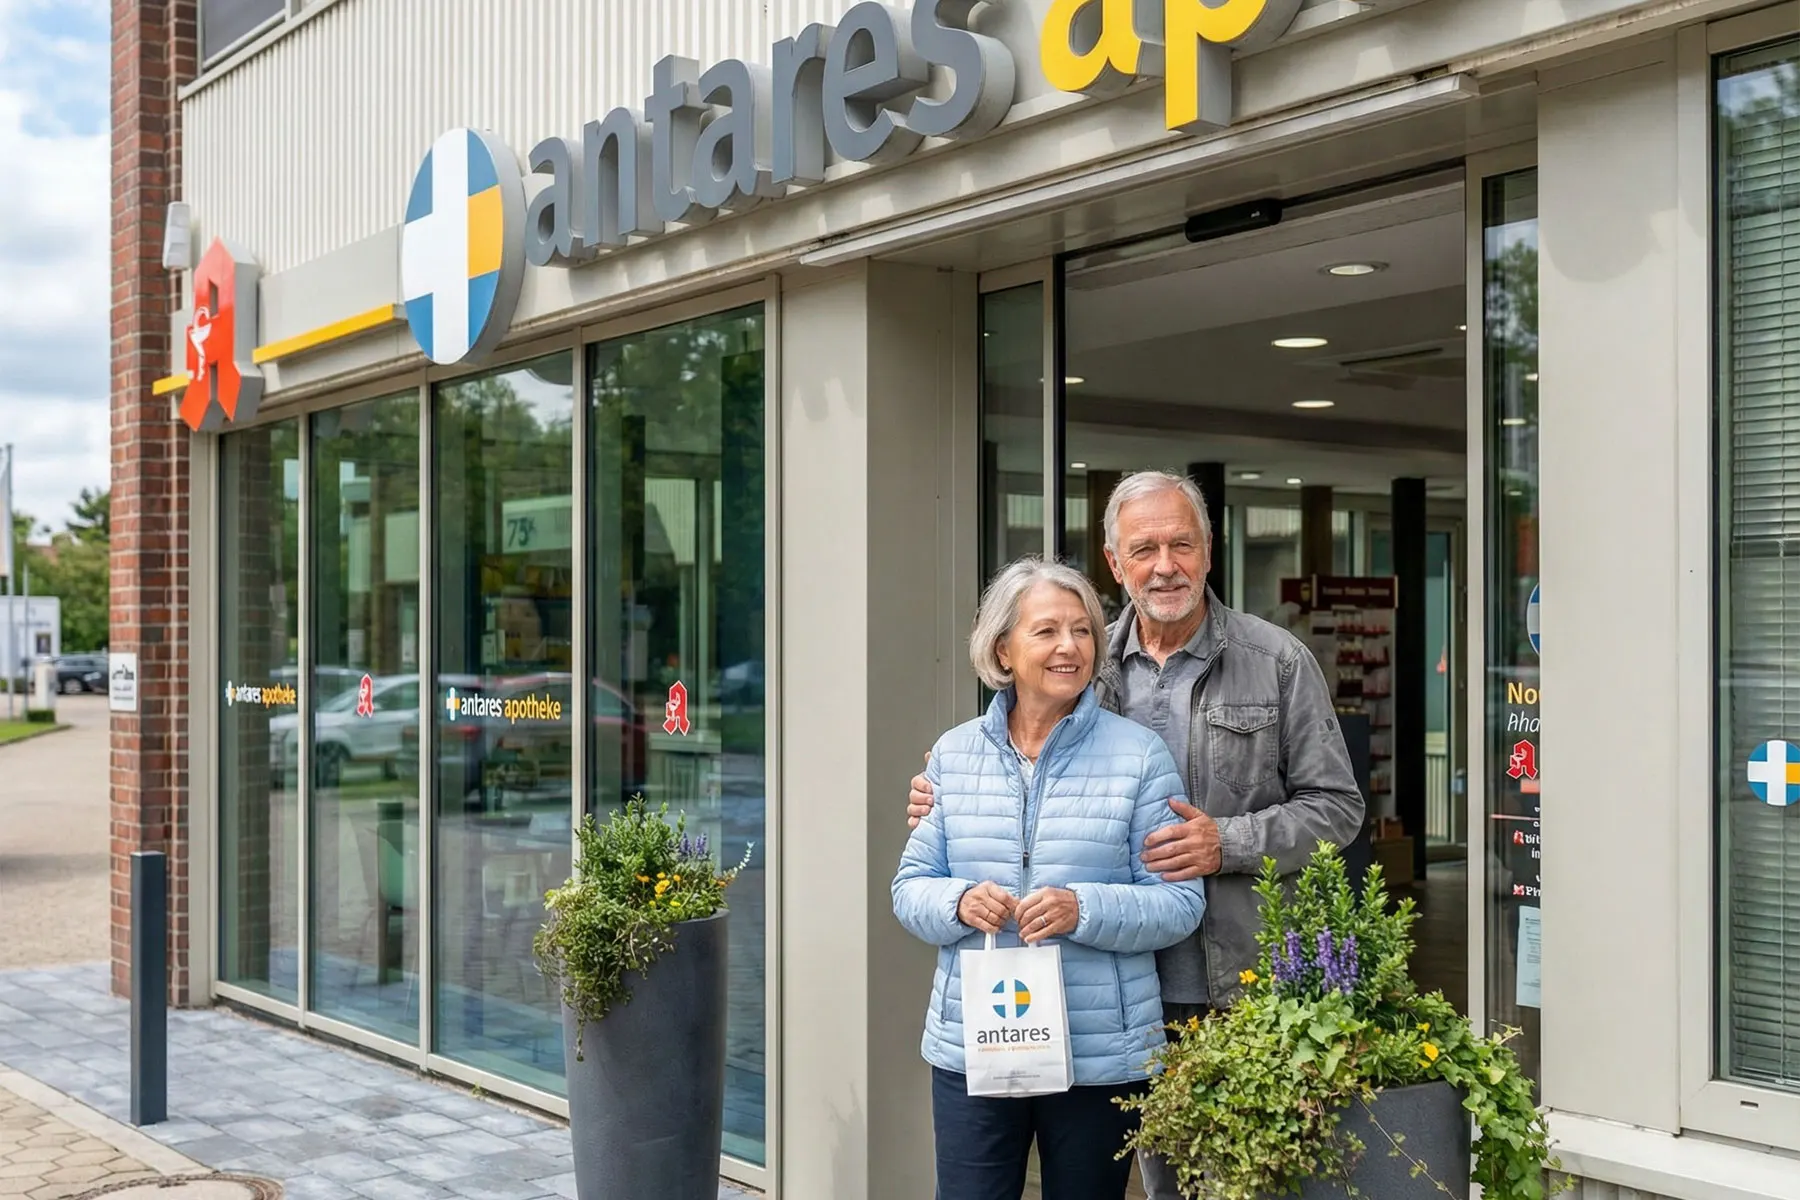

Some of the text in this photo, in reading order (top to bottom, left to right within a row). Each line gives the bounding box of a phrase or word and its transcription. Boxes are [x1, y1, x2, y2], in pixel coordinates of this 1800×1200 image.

[526, 0, 1010, 267] antares
[1508, 682, 1540, 705] No
[461, 693, 561, 725] antares apotheke
[977, 1026, 1050, 1044] antares
